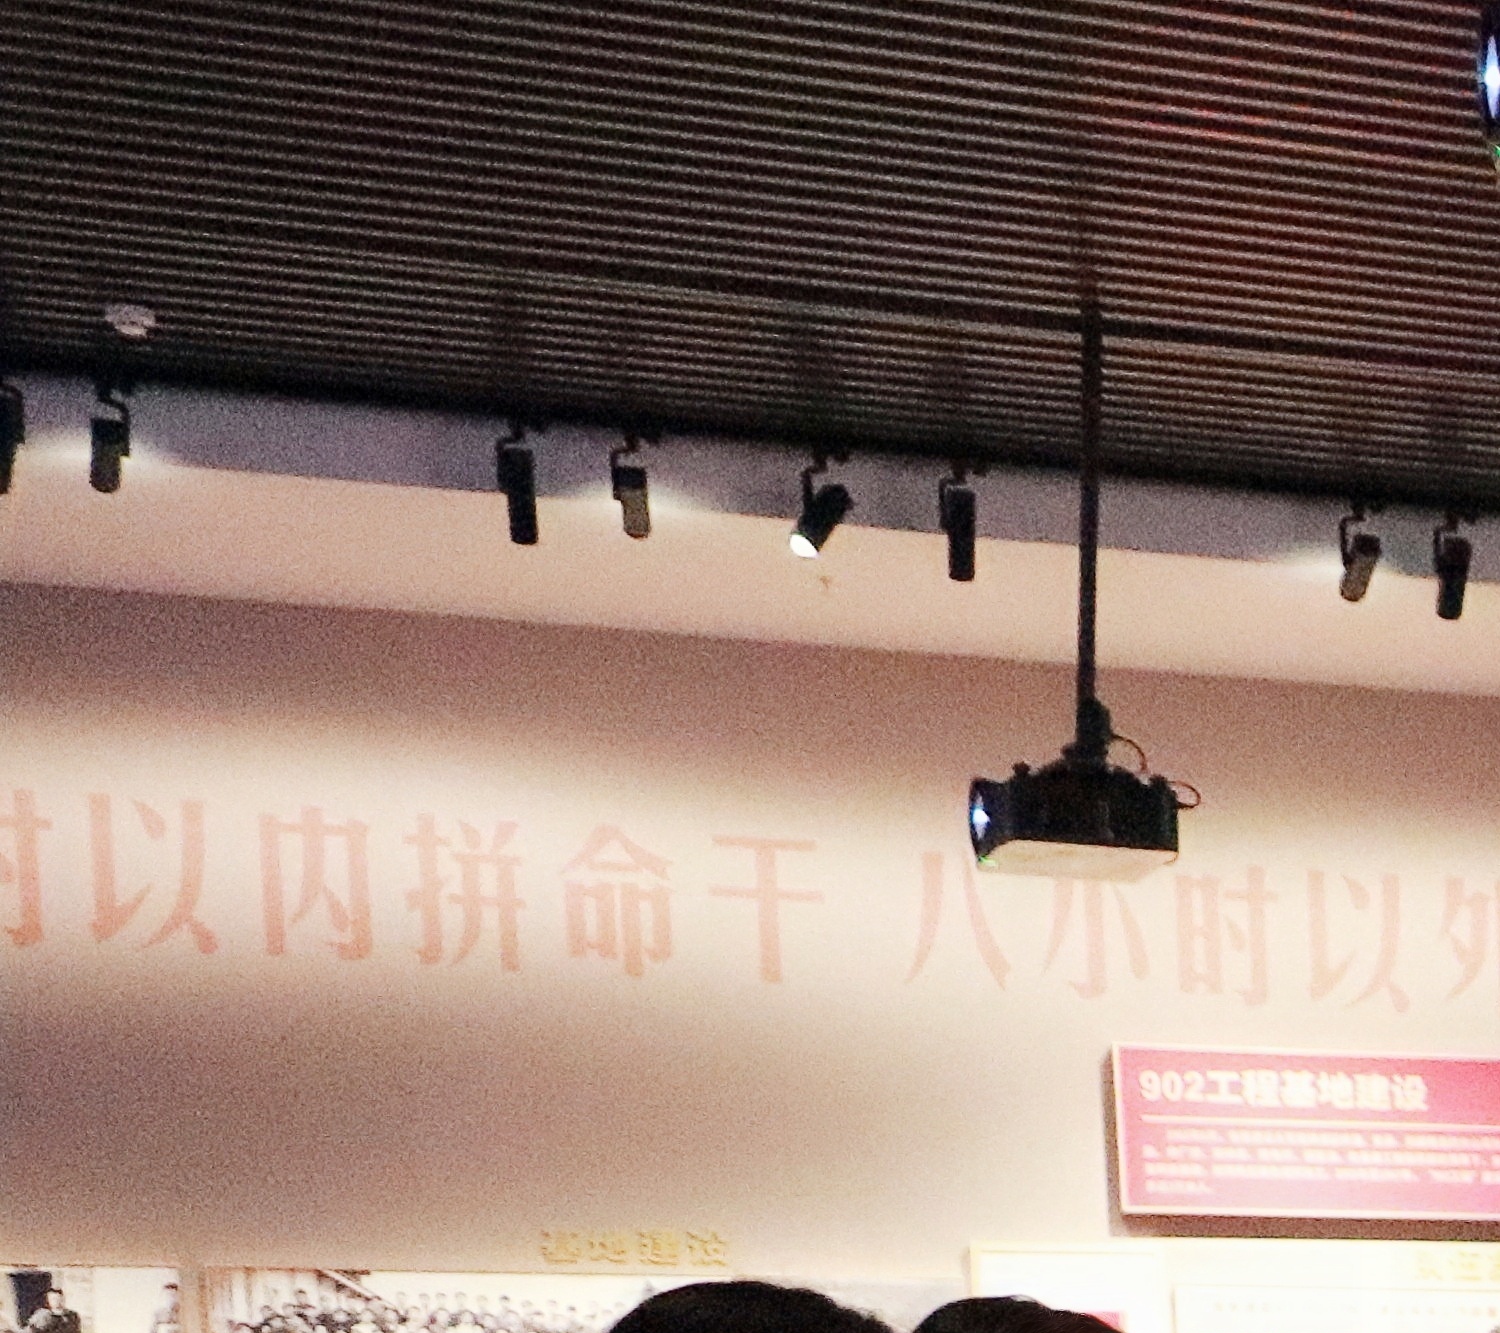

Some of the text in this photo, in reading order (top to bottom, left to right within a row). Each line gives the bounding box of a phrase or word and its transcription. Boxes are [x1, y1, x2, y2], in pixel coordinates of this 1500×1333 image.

[1138, 1068, 1430, 1112] 902工程基地建设
